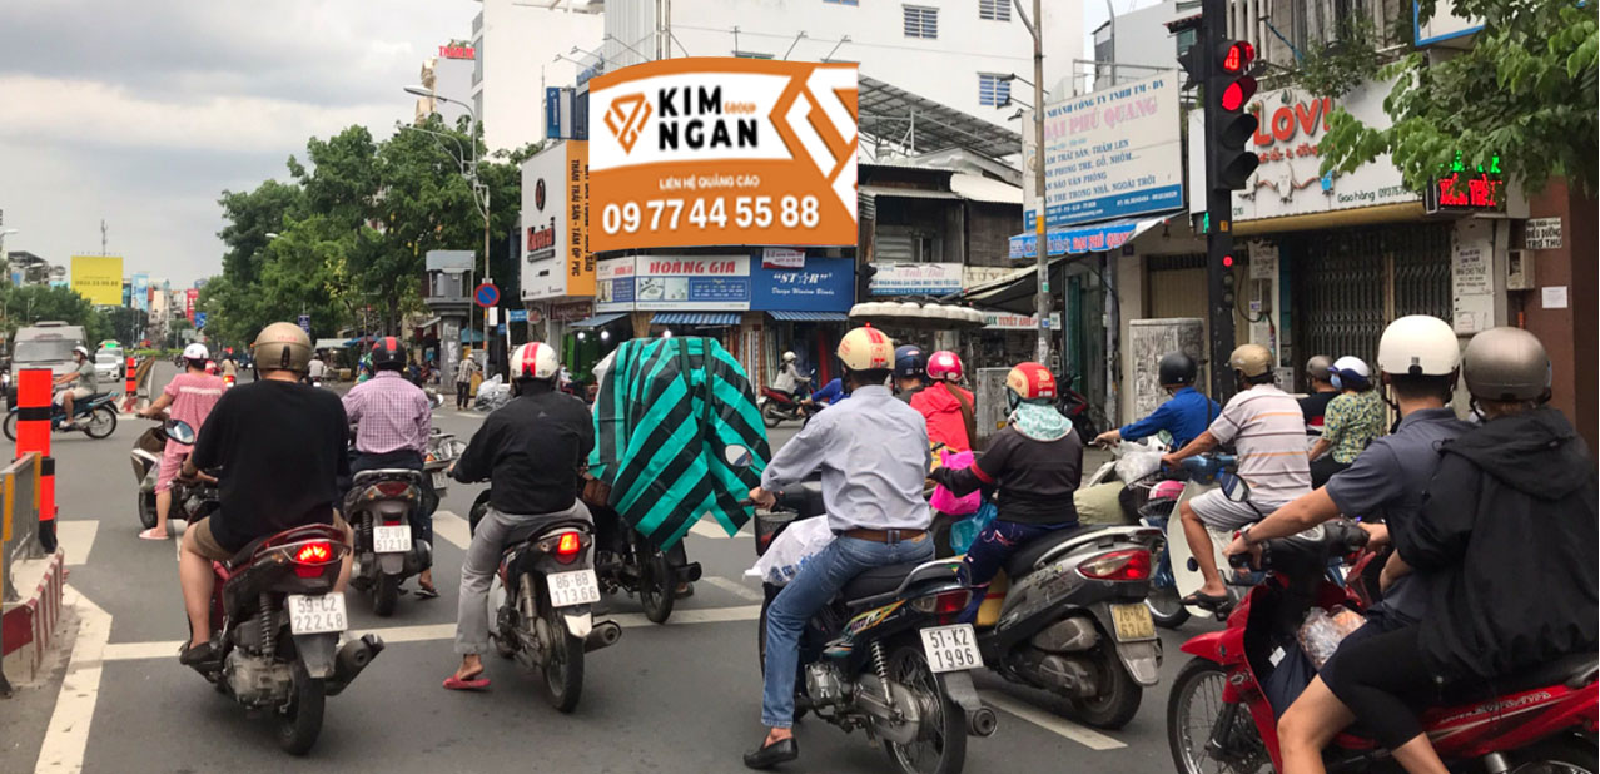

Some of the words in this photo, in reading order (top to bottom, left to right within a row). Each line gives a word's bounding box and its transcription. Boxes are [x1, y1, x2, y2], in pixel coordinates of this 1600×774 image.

[659, 85, 722, 117] KIM
[724, 102, 756, 115] GROUP
[1103, 96, 1158, 129] QUANG
[659, 119, 758, 151] NGAN
[659, 177, 681, 190] LIÊN
[683, 175, 696, 190] HỆ
[699, 173, 734, 188] QUẢNG
[737, 174, 760, 187] CÁO
[602, 202, 641, 234] 09
[646, 198, 685, 231] 77
[689, 197, 727, 229] 44
[735, 197, 772, 228] 55
[780, 194, 820, 228] 88
[571, 261, 582, 277] PVC
[650, 259, 705, 274] HOÀNG
[298, 597, 337, 614] 59-C2
[294, 614, 344, 632] 222.48
[934, 650, 974, 669] 1996
